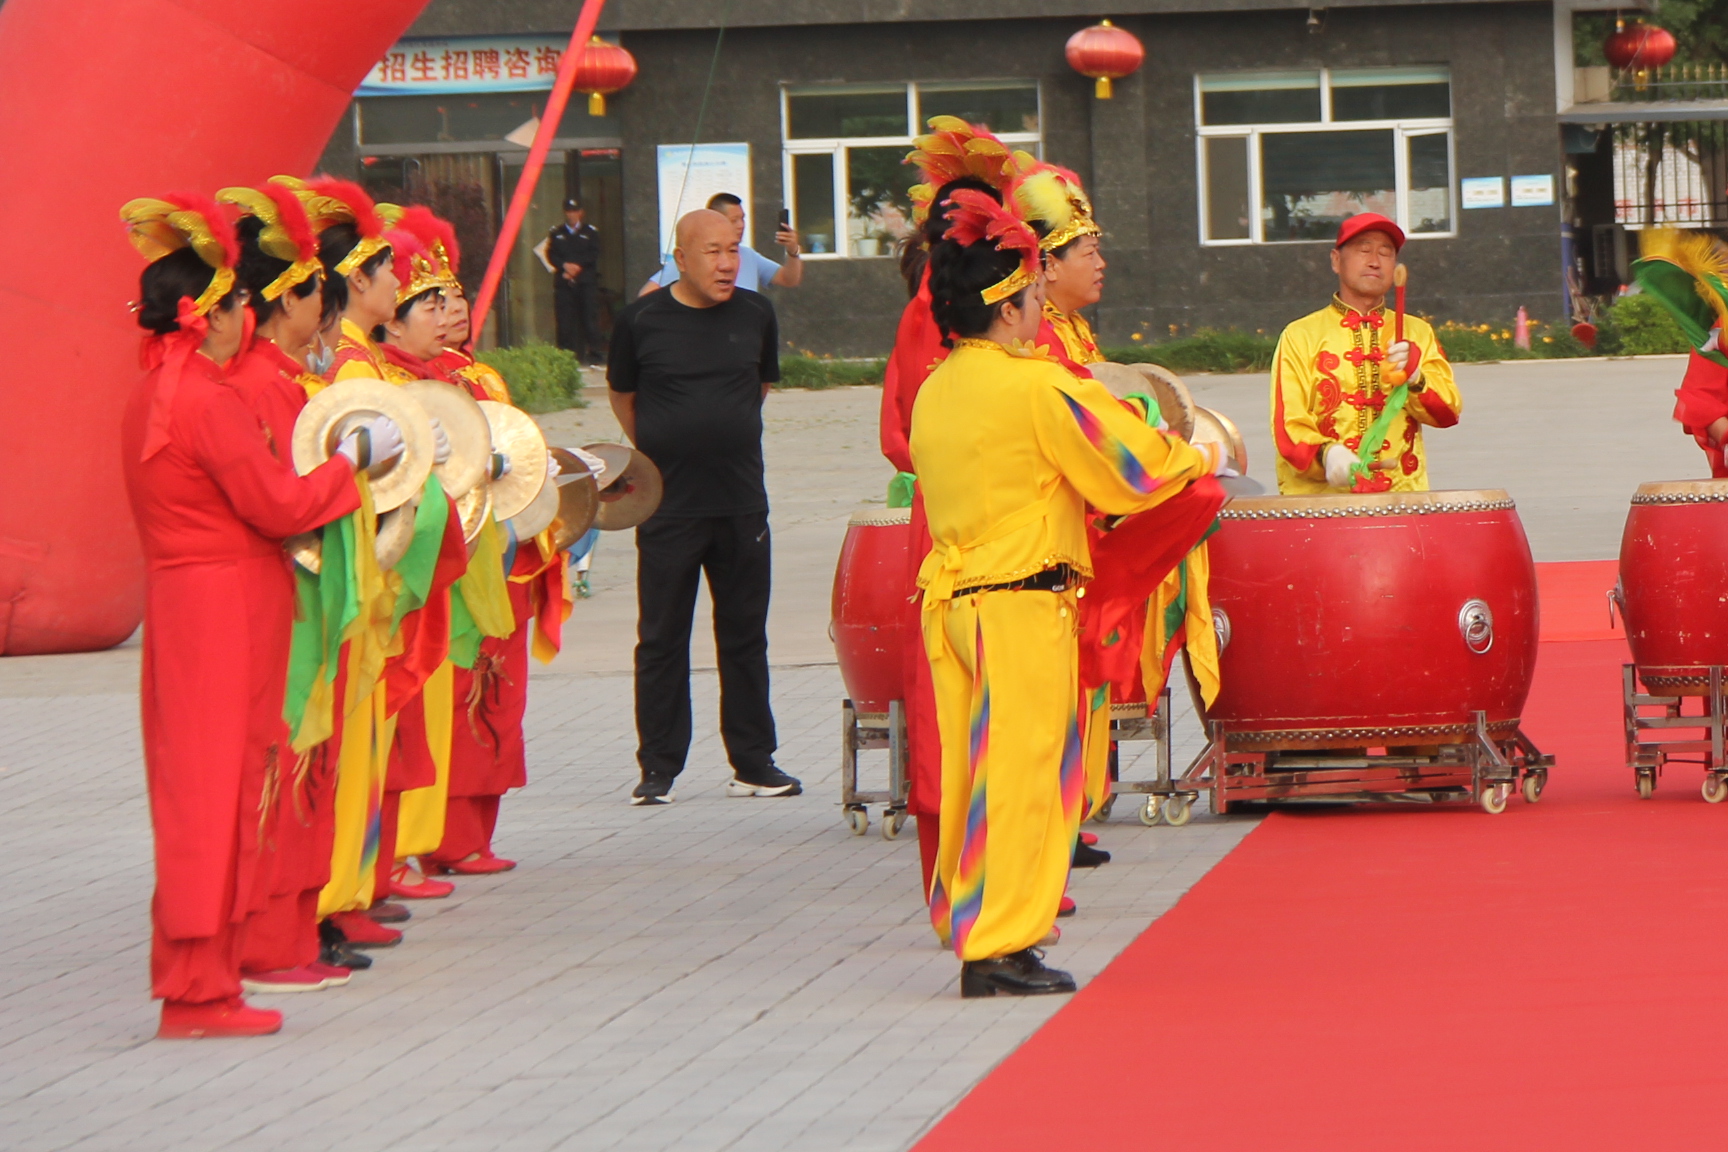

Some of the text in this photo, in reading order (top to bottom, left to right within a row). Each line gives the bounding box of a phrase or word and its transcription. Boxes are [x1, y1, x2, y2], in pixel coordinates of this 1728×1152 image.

[378, 46, 562, 83] 招生招聘咨询
